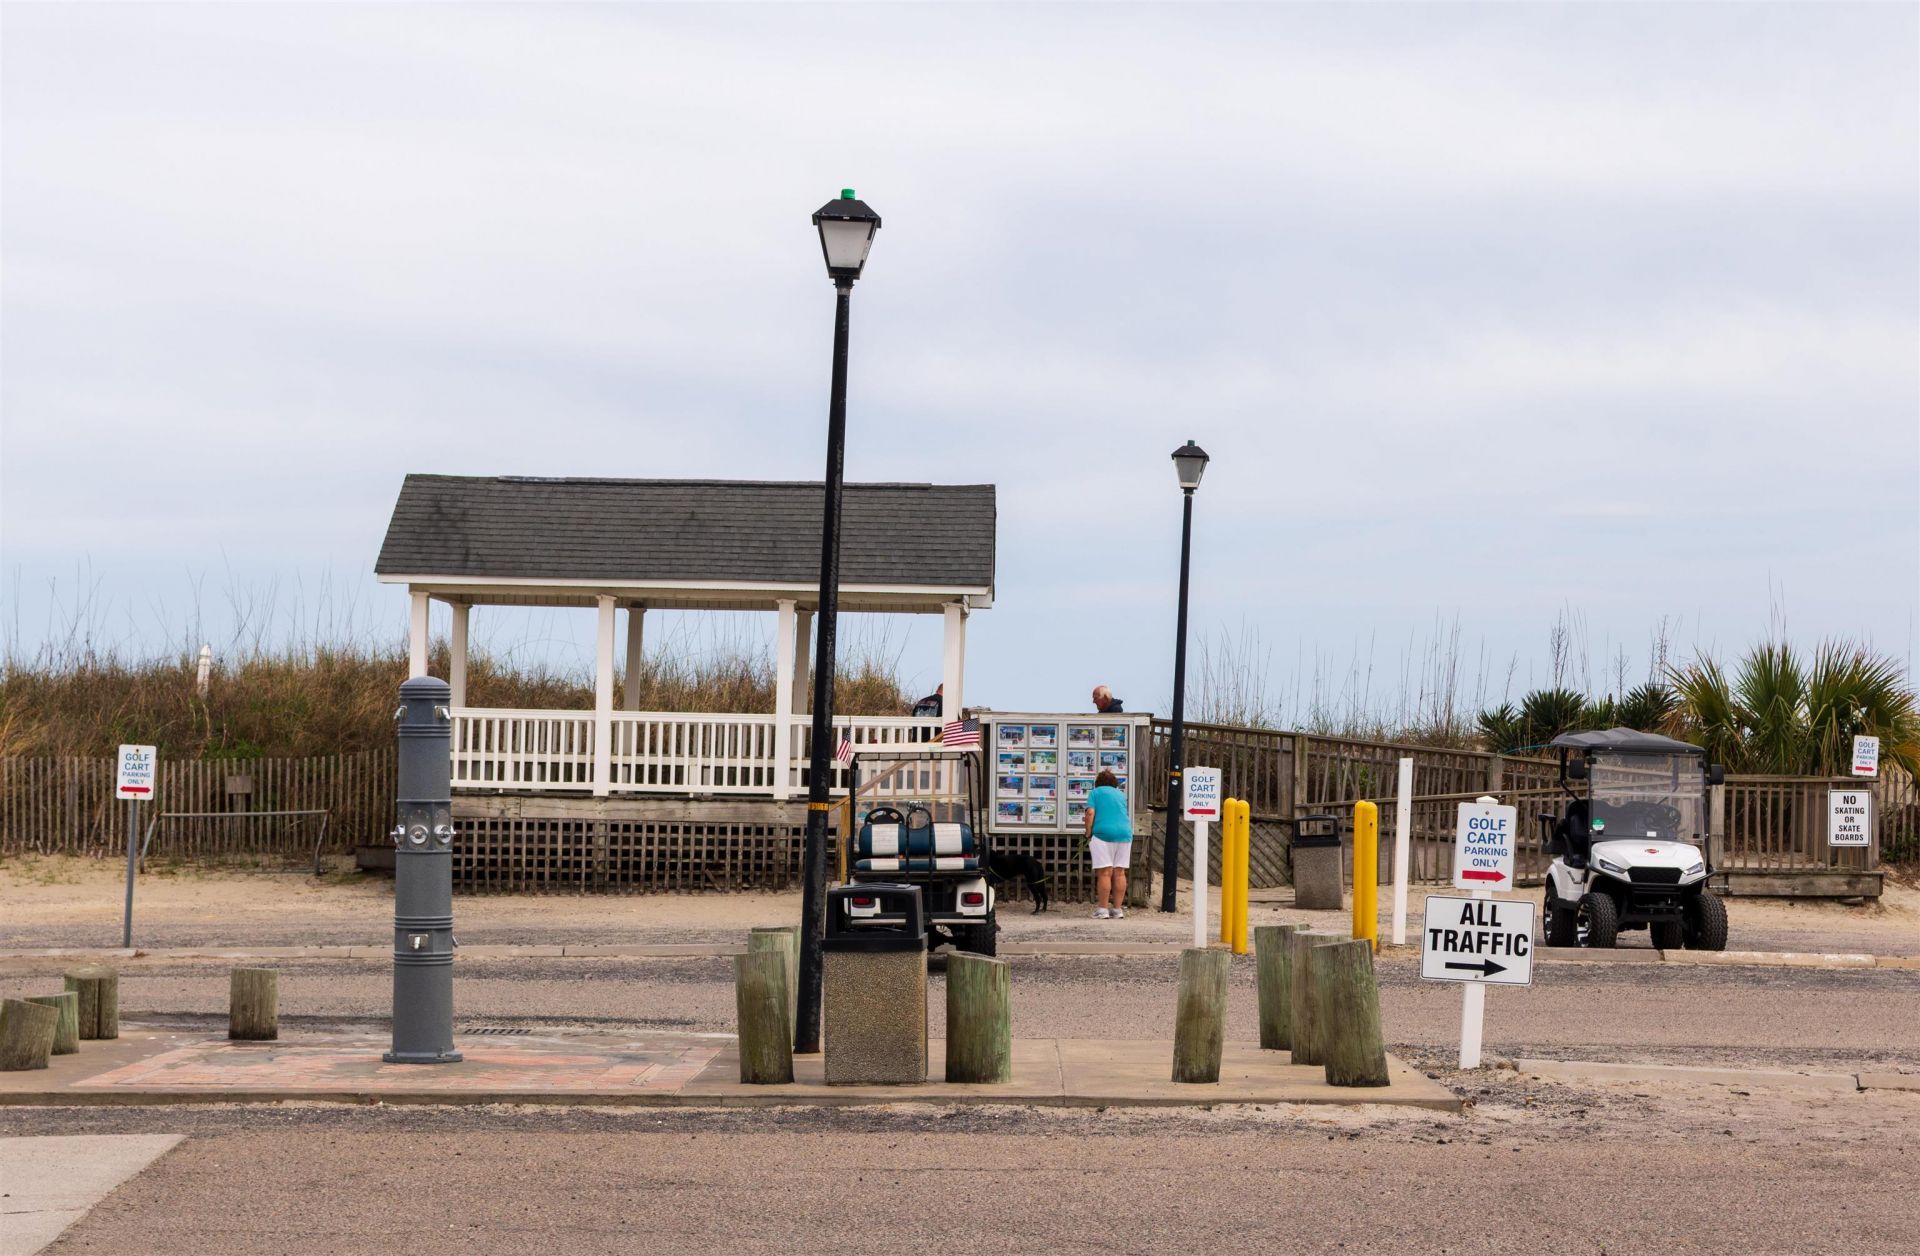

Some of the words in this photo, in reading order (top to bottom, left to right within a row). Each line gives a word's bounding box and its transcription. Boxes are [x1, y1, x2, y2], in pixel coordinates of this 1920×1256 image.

[125, 753, 150, 761] GOLF
[124, 763, 150, 771] CART
[1191, 775, 1215, 783] GOLF
[1190, 784, 1215, 792] CART
[1843, 795, 1857, 805] NO
[1834, 807, 1865, 815] SKATING
[1469, 817, 1507, 831] GOLF
[1467, 831, 1507, 845] CART
[1835, 833, 1864, 841] BOARDS
[1464, 846, 1508, 857] PARKING
[1472, 858, 1499, 868] ONLY
[1459, 902, 1502, 928] ALL
[1429, 928, 1529, 957] TRAFFIC
